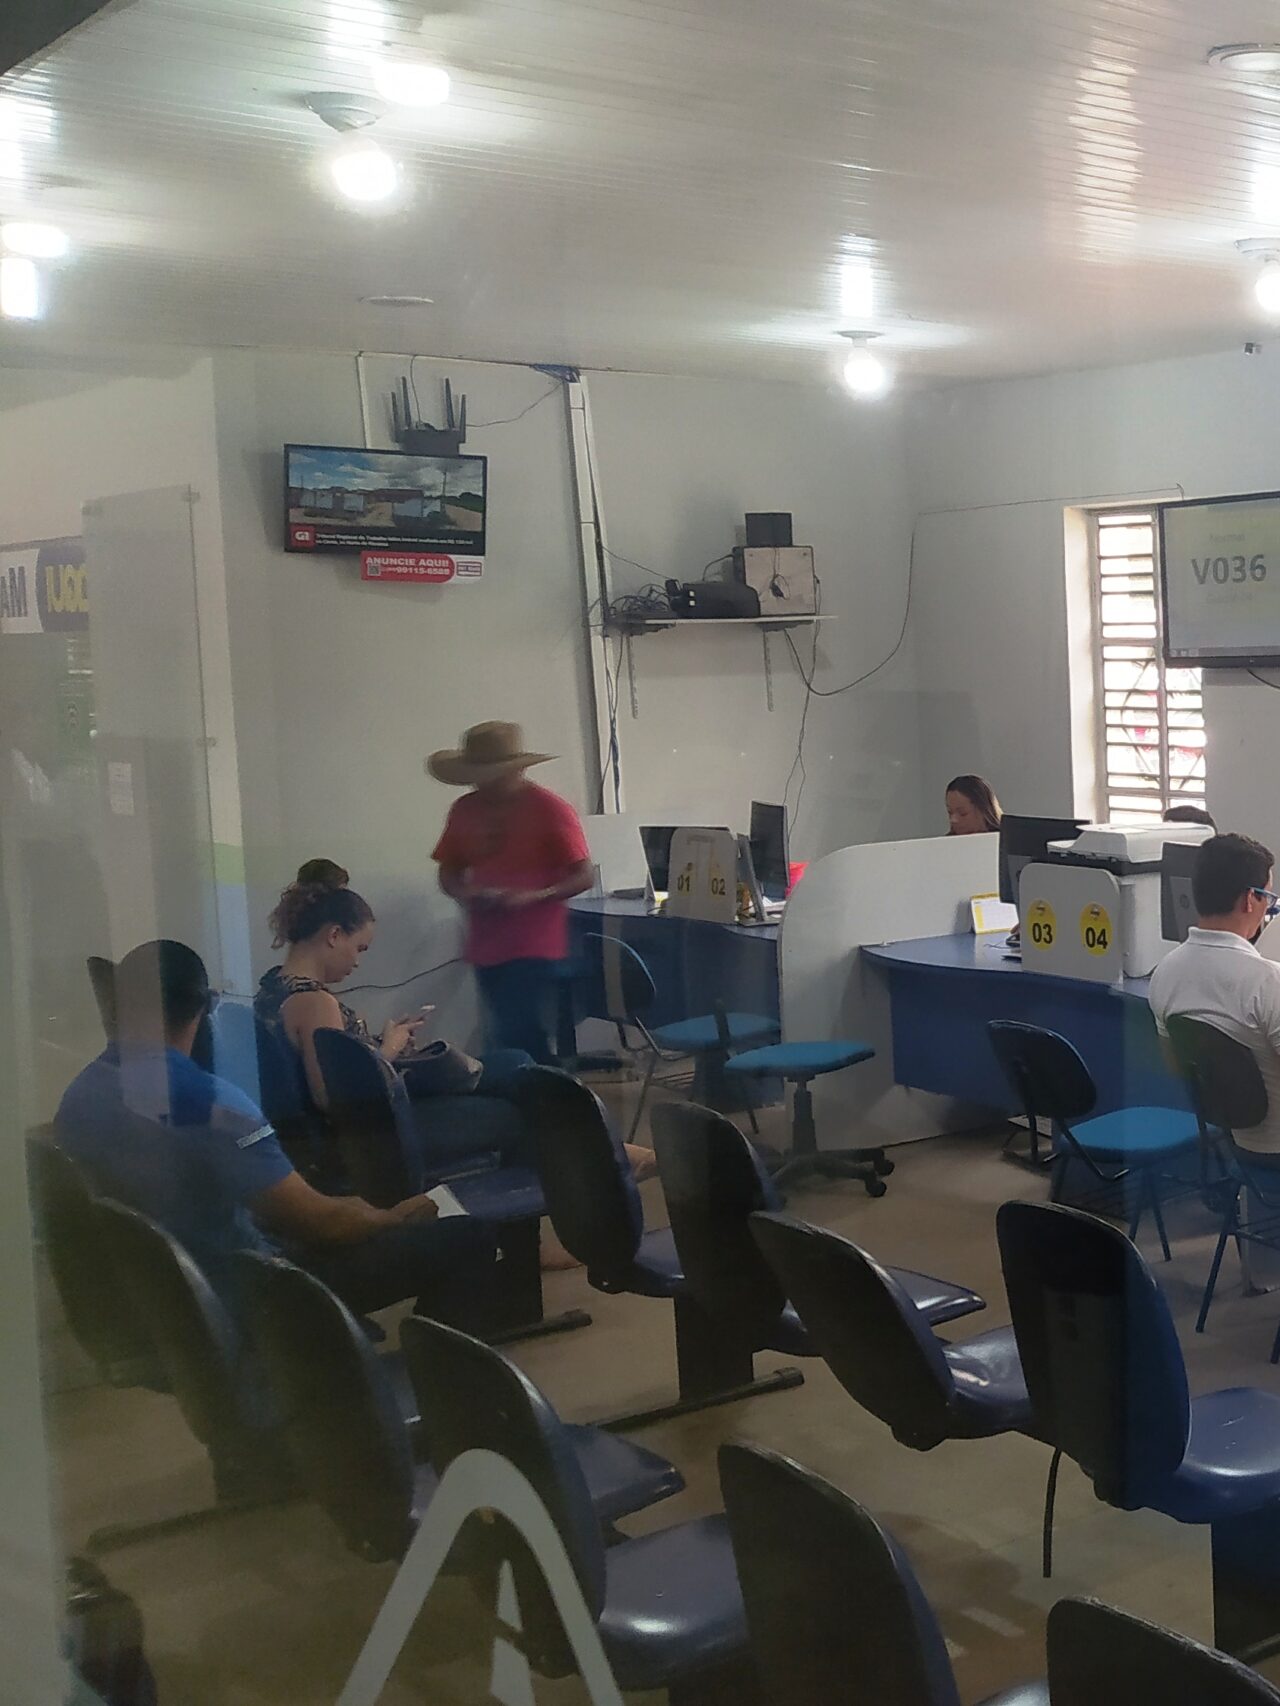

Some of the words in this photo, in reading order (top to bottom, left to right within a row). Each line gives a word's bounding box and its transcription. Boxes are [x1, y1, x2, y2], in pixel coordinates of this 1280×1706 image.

[366, 557, 416, 566] ANUNCIE
[1191, 553, 1267, 585] V036
[677, 874, 691, 892] 01
[711, 878, 726, 896] 02
[1032, 922, 1053, 944] 03
[1085, 927, 1108, 950] 04
